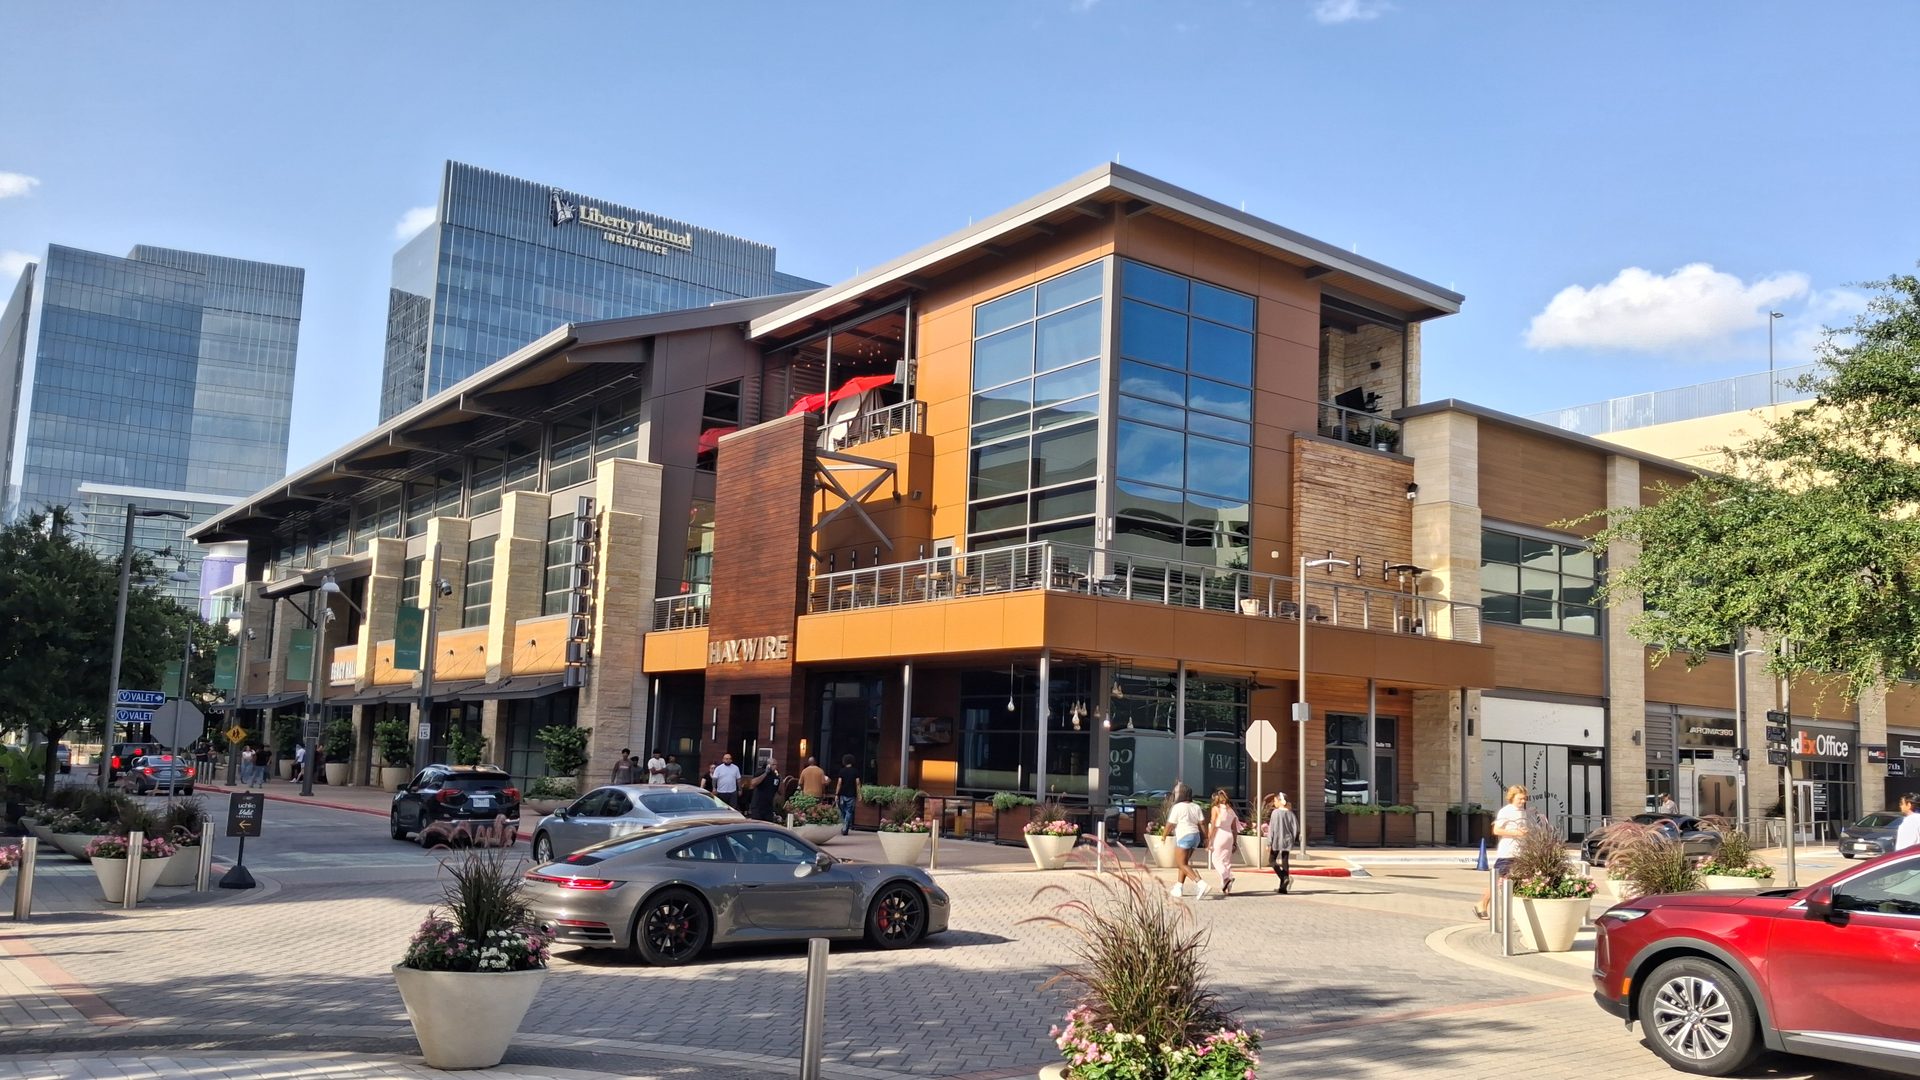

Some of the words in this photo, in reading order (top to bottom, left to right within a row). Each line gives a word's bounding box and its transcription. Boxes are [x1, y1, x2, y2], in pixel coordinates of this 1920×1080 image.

[579, 205, 635, 236] Liberty
[637, 220, 692, 247] Mutual
[603, 232, 669, 256] INSURANCE
[708, 634, 789, 664] HAYWIRE
[131, 693, 156, 702] VALET
[129, 711, 153, 721] VALET
[1689, 726, 1734, 737] AROMA360
[1816, 734, 1849, 757] Office
